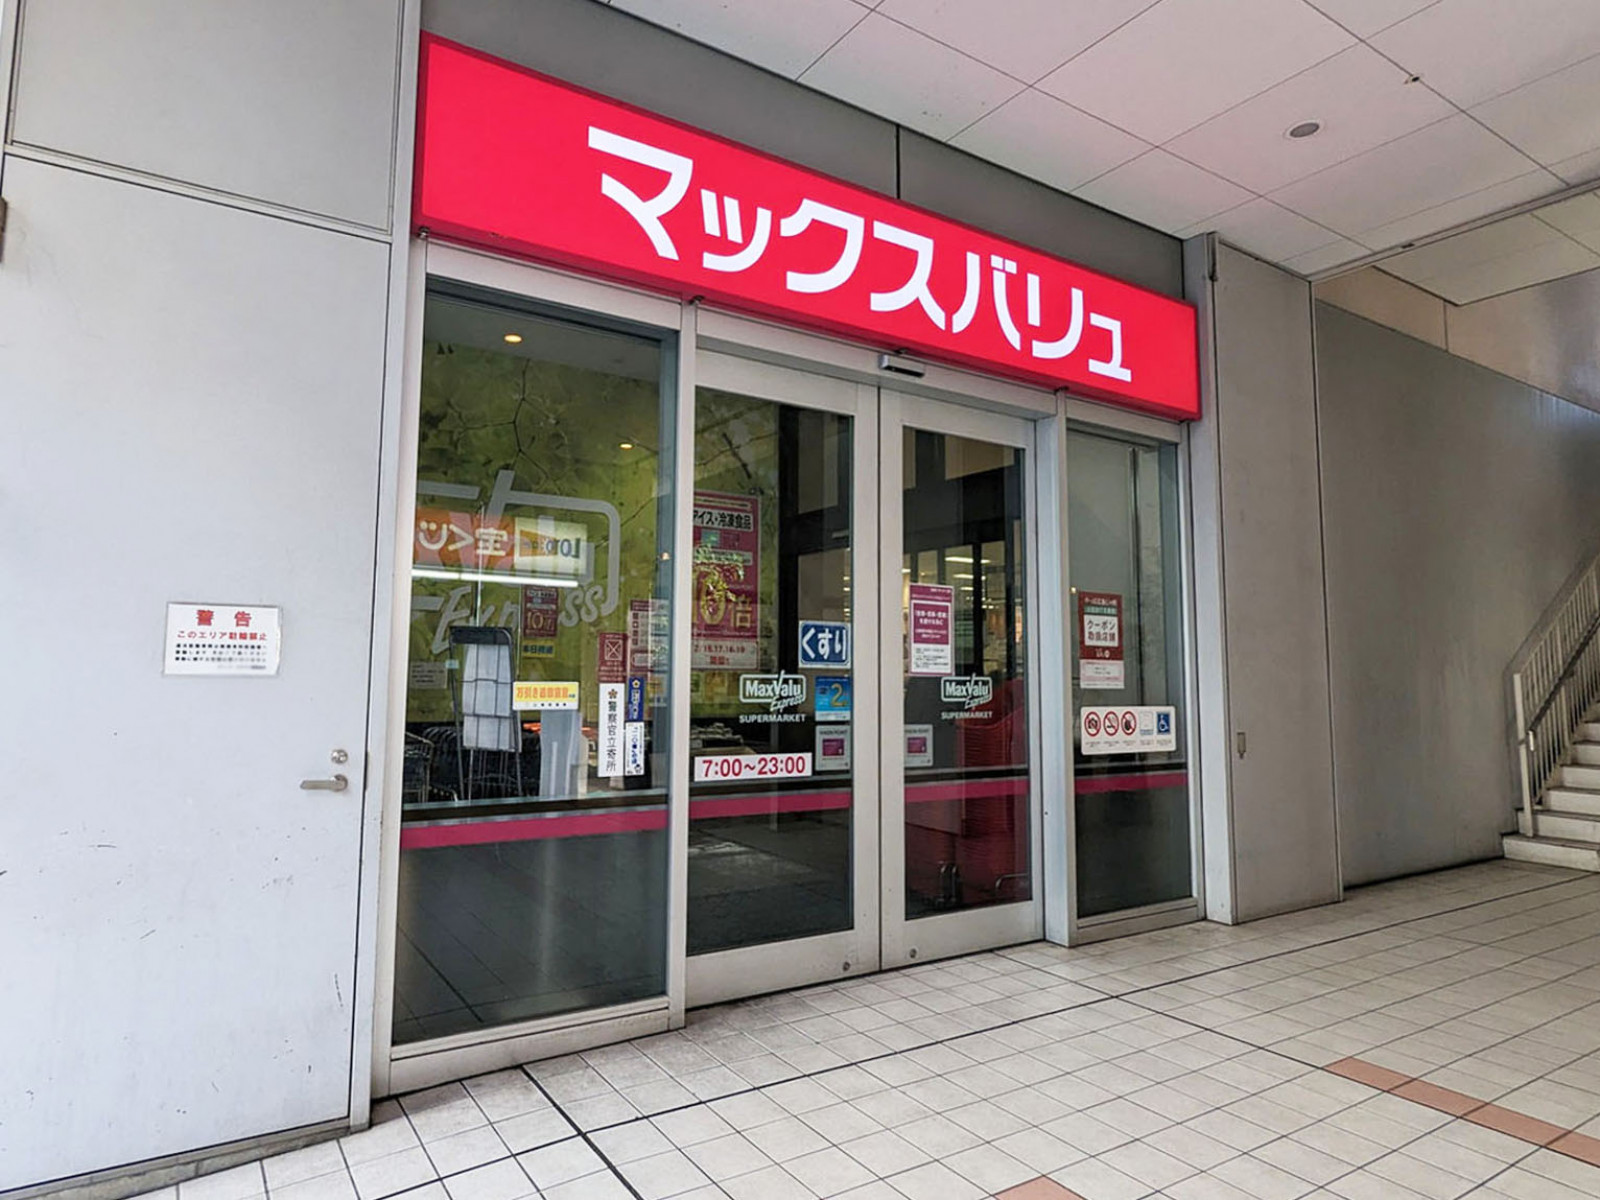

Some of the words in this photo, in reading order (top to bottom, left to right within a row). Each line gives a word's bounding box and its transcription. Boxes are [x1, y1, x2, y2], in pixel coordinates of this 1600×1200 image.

[588, 126, 1131, 382] マックスバリュ
[1087, 620, 1116, 631] クーポン
[802, 628, 846, 660] くすり
[745, 670, 801, 698] MaxValu
[945, 672, 989, 697] MaxValu
[739, 713, 806, 723] SUPERMARKET
[606, 701, 618, 772] 警察官立寄所
